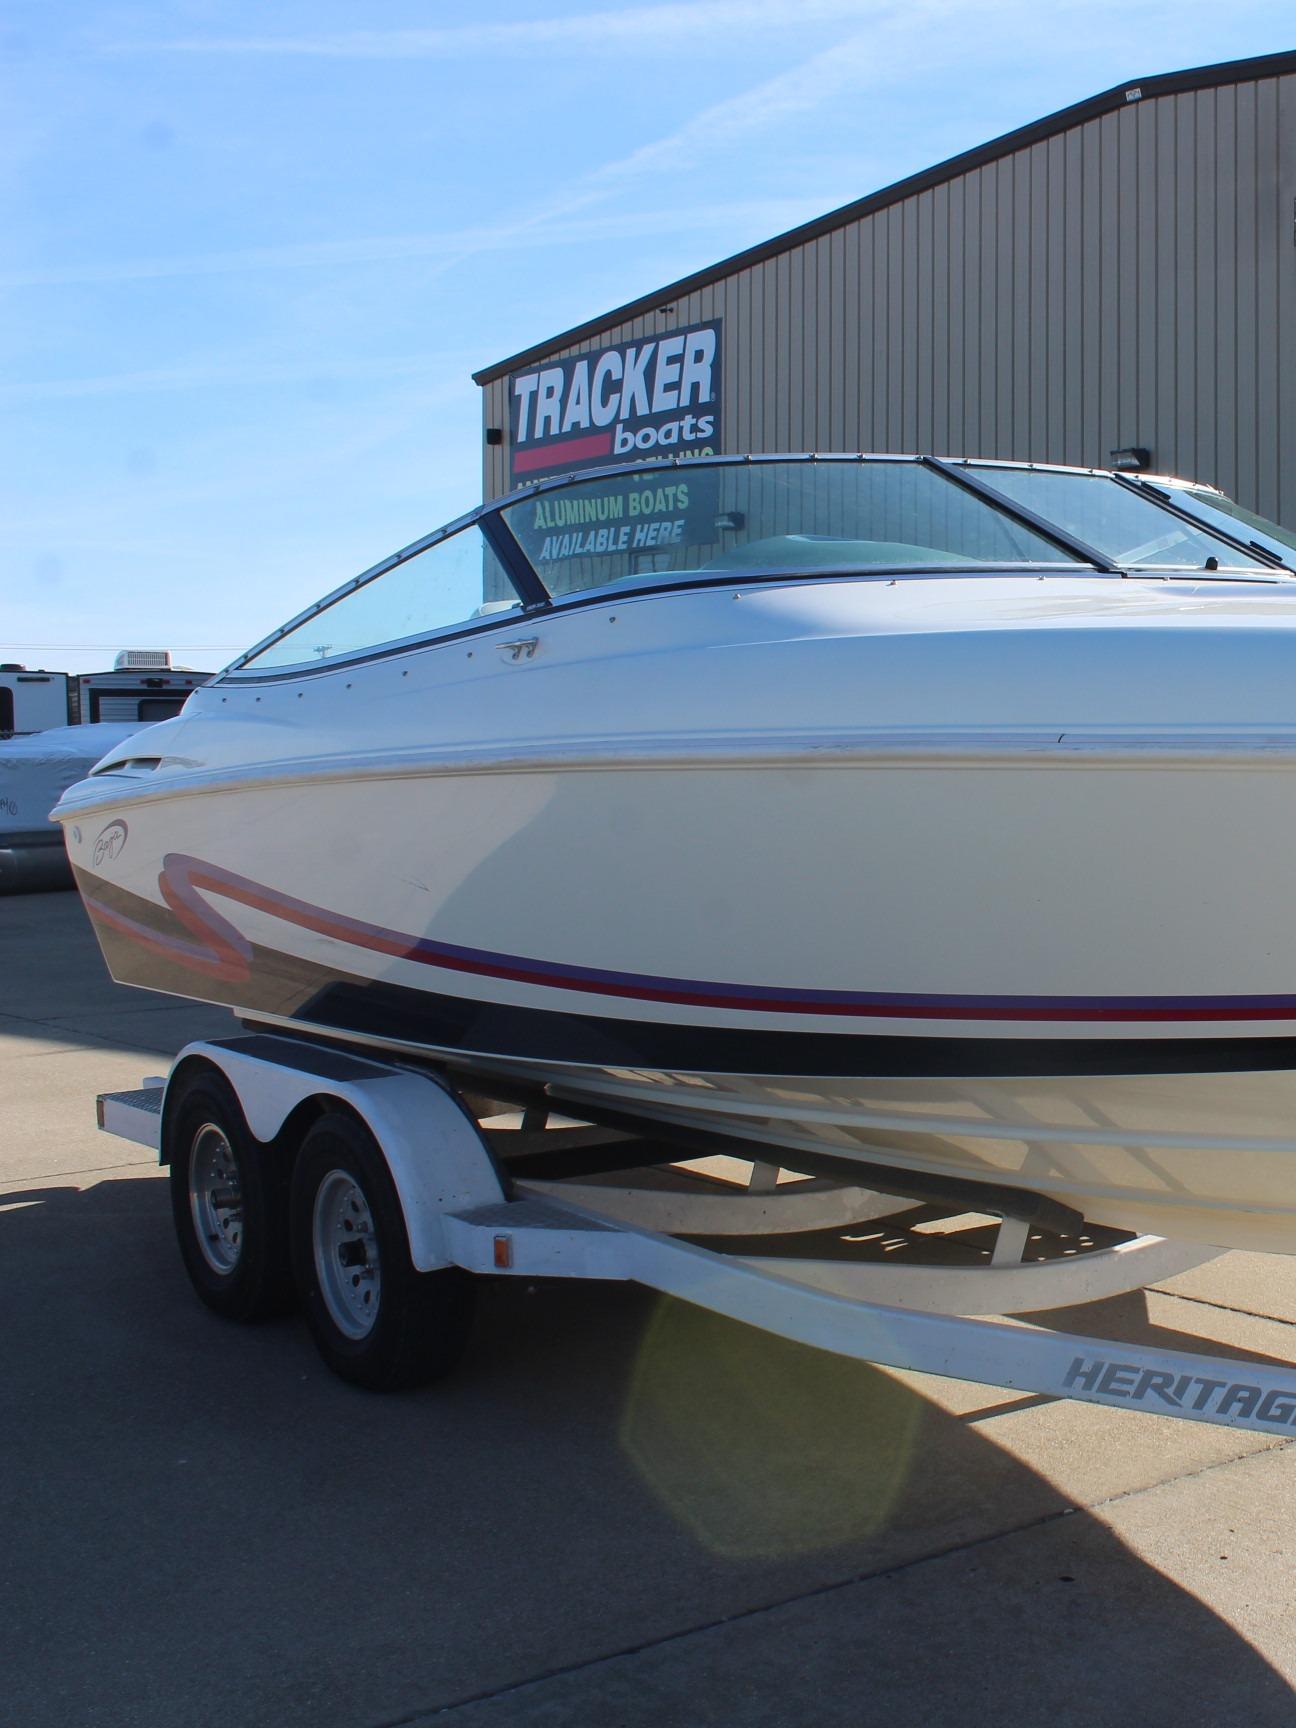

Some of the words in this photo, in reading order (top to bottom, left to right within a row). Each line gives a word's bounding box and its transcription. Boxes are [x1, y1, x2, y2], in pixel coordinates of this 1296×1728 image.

[513, 328, 716, 443] TRACKER
[613, 414, 714, 455] boats
[534, 495, 624, 530] ALUMINUM
[628, 483, 689, 516] BOATS
[538, 525, 631, 561] AVAILABLE
[632, 519, 685, 548] HERE
